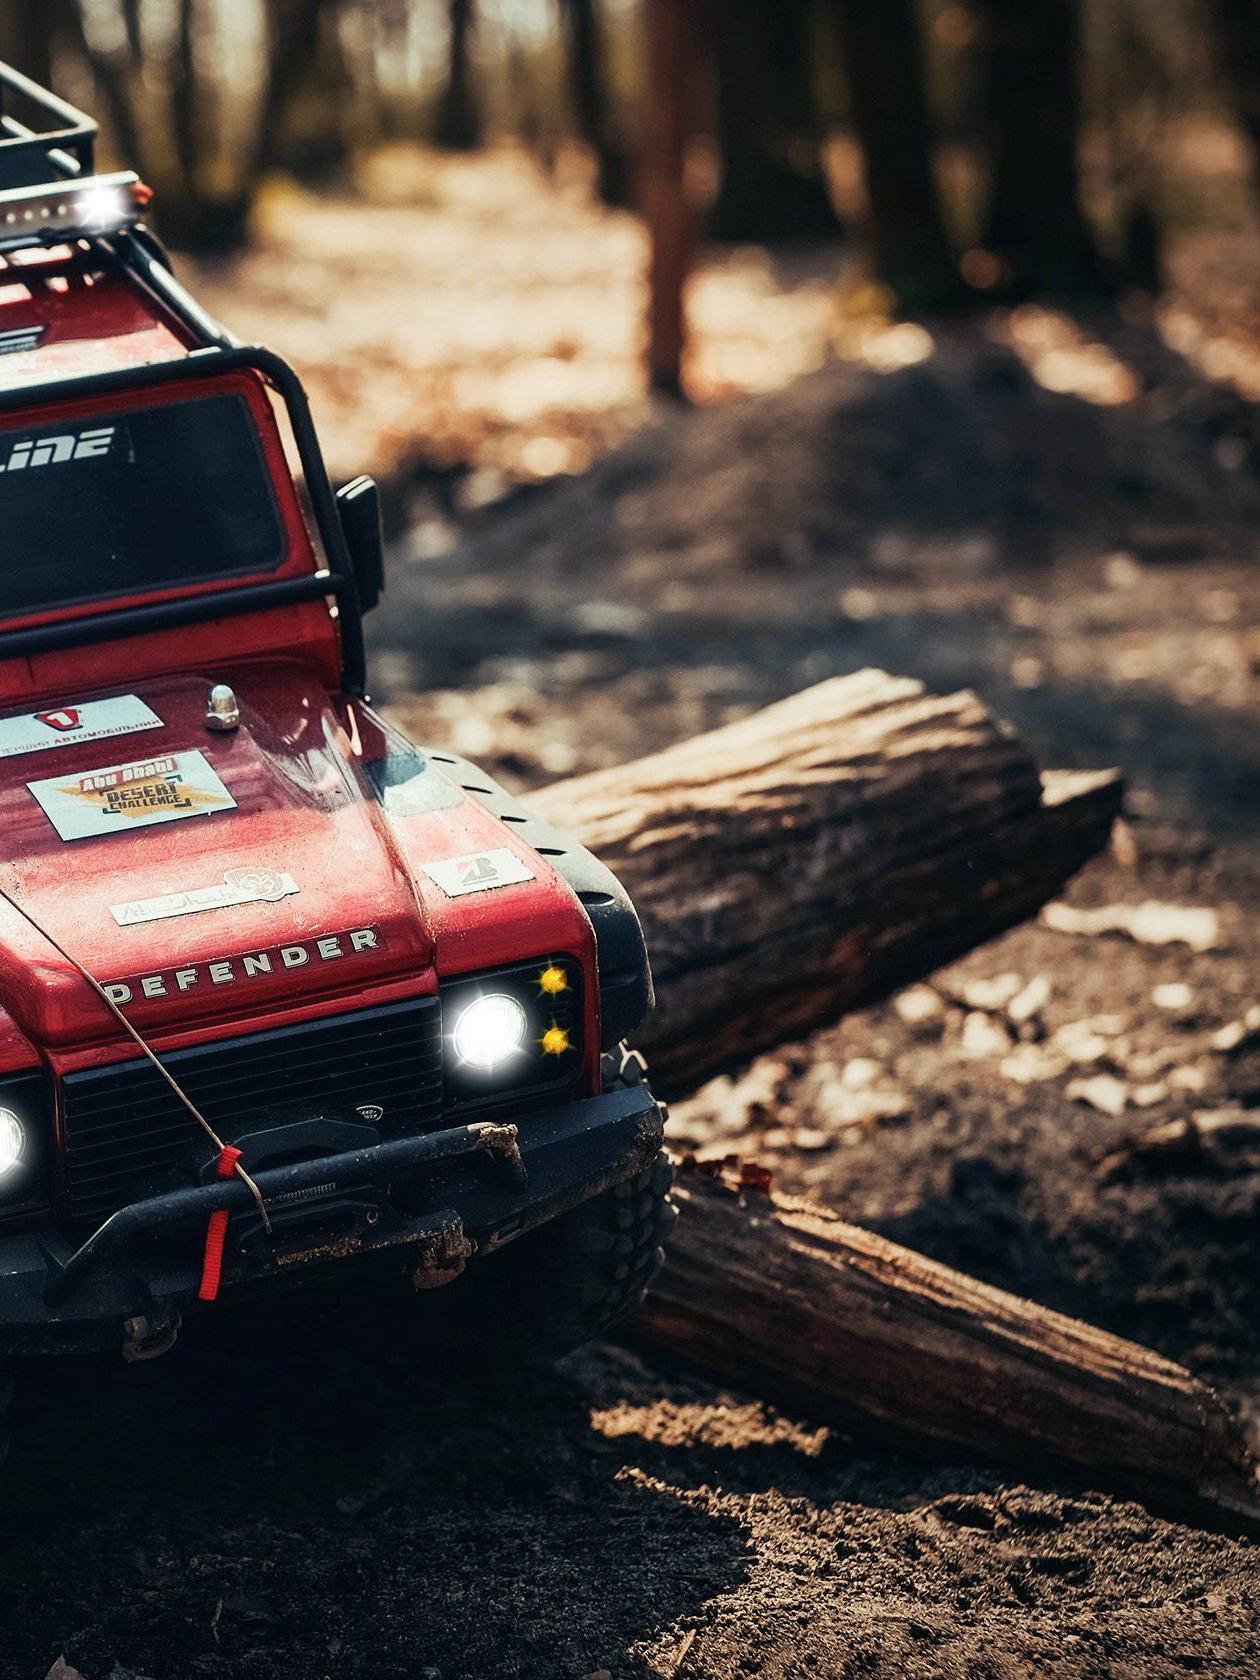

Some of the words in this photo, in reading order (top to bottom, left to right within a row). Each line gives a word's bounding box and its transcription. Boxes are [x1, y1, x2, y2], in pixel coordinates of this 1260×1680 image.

[82, 773, 118, 793] Abu
[106, 781, 179, 804] DESERT
[109, 794, 183, 811] CHALLENGE
[104, 929, 379, 1005] DEFENDER
